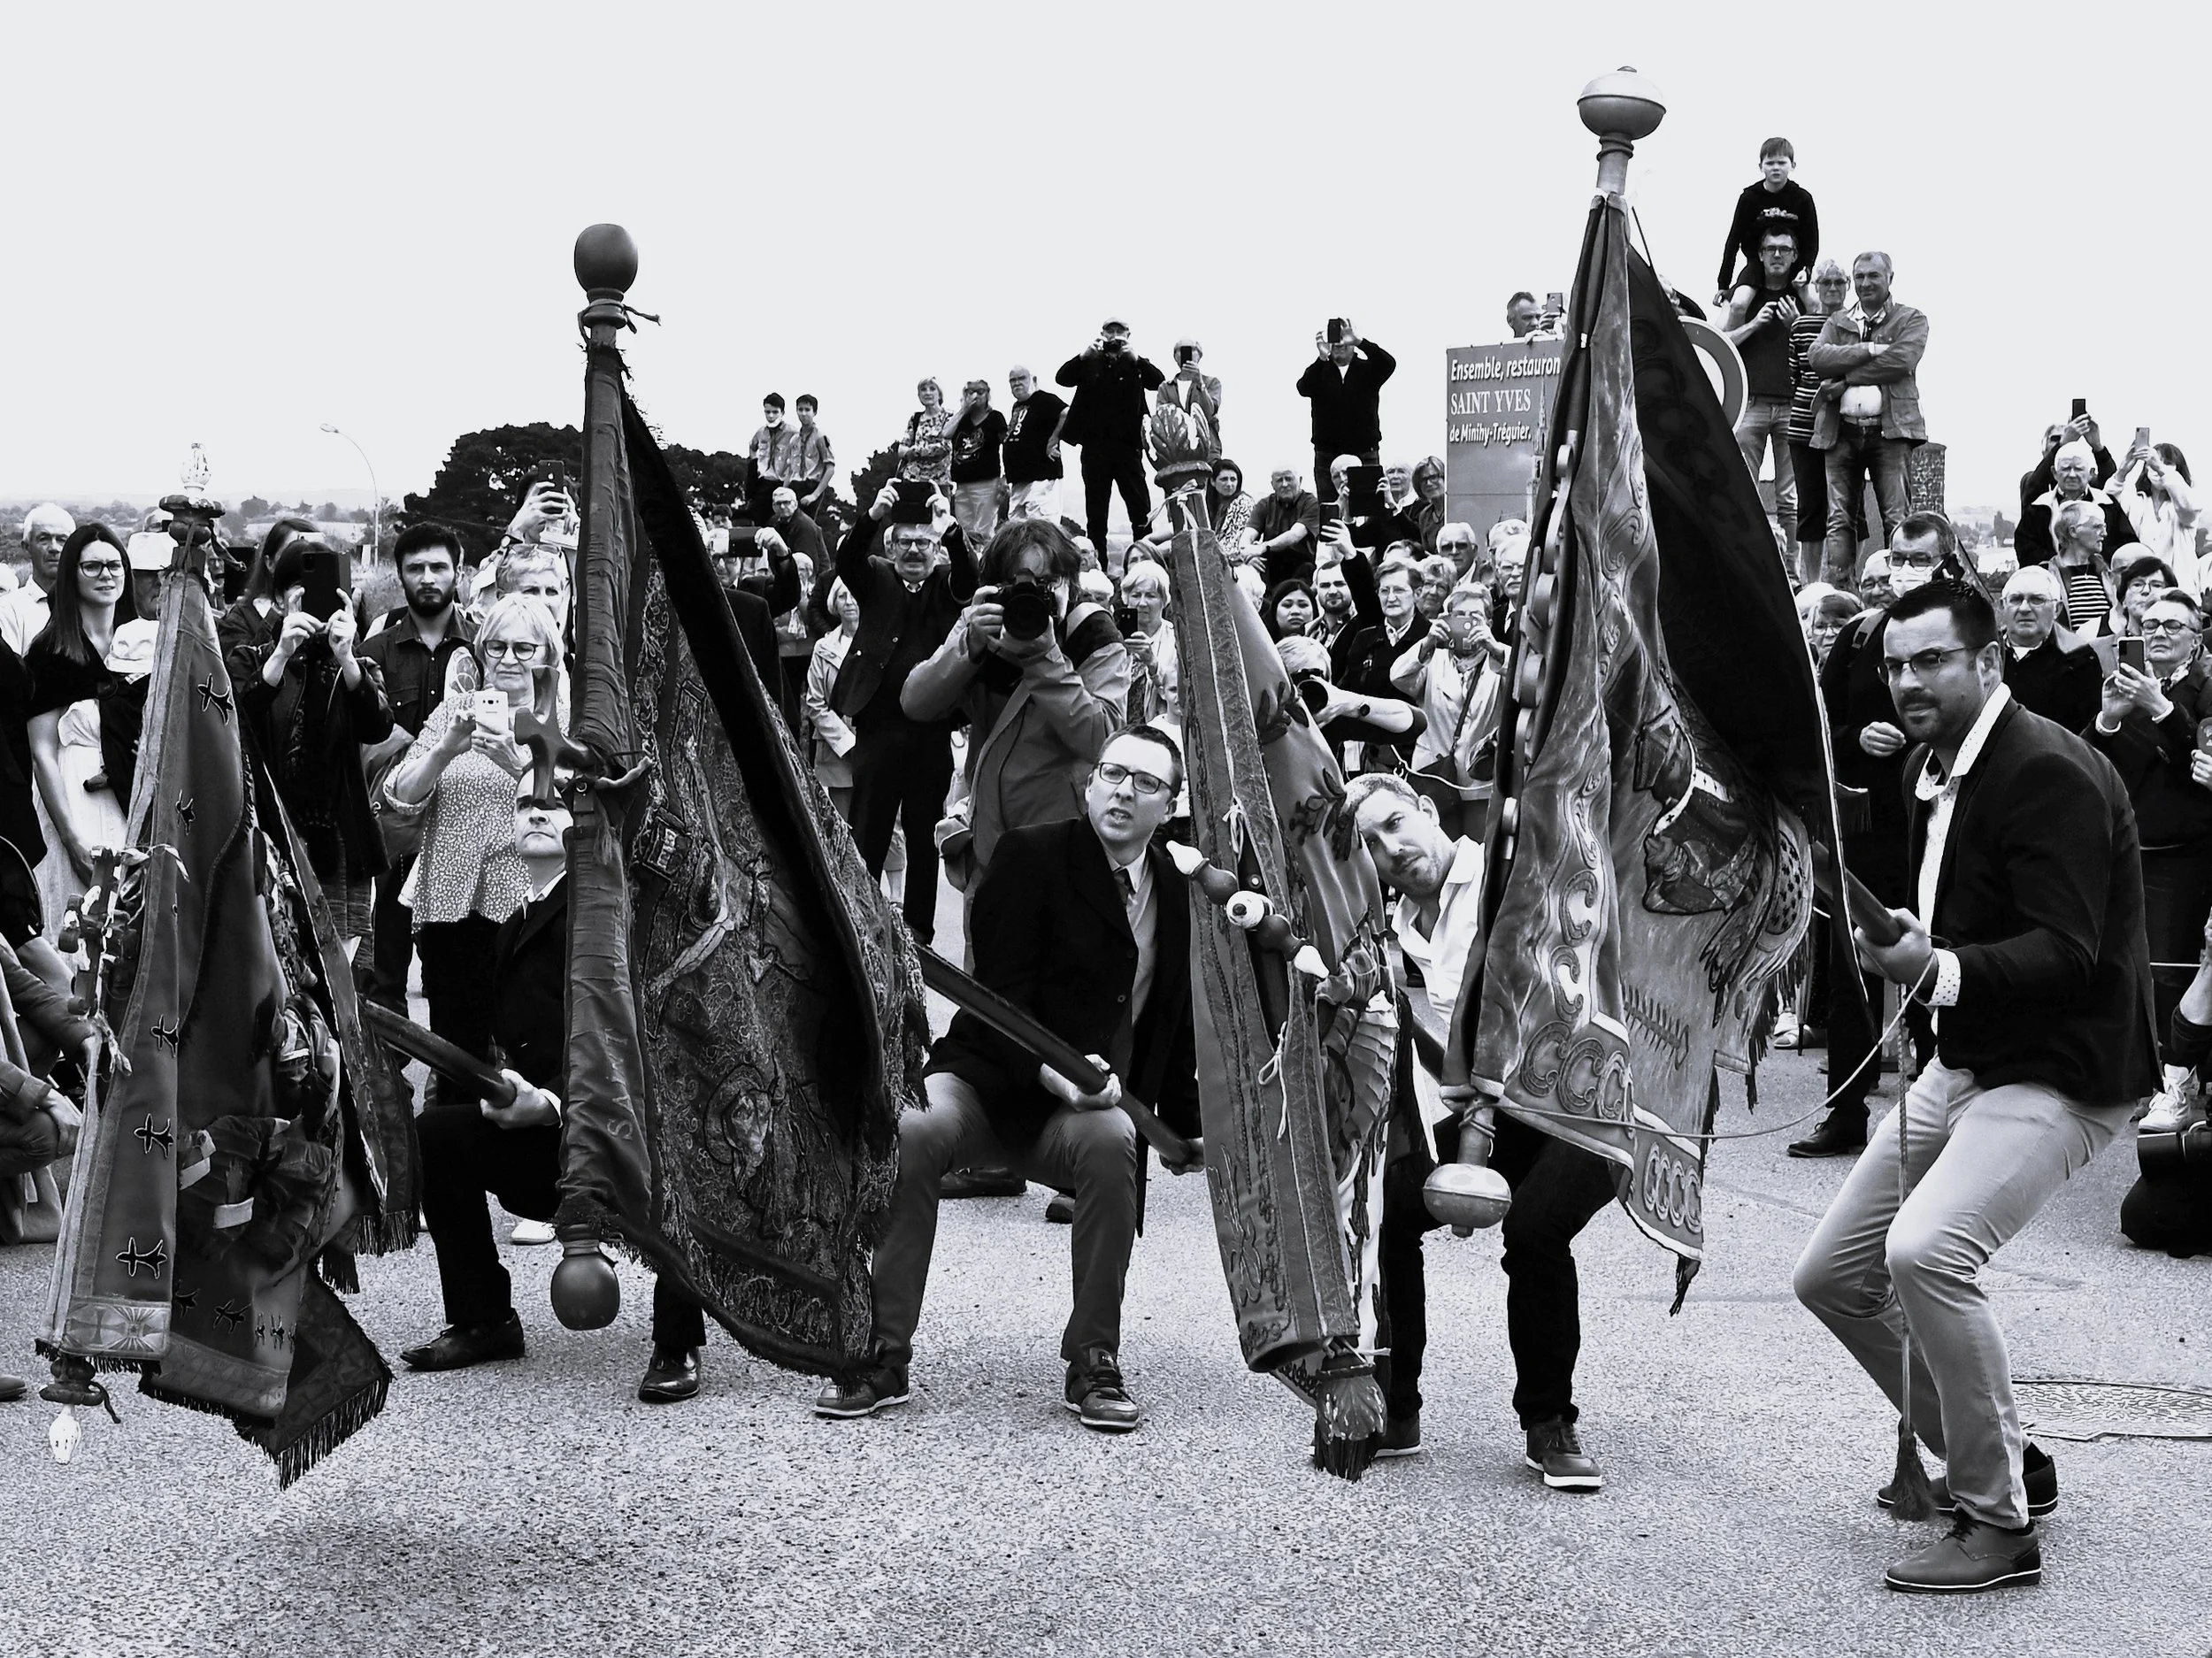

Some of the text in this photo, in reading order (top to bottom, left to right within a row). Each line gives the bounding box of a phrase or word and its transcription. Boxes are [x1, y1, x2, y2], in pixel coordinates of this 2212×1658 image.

[1451, 355, 1561, 381] Ensemble, restauron
[1450, 388, 1532, 415] SAINT YVES
[1449, 421, 1532, 447] de Minihy-Tréguier.
